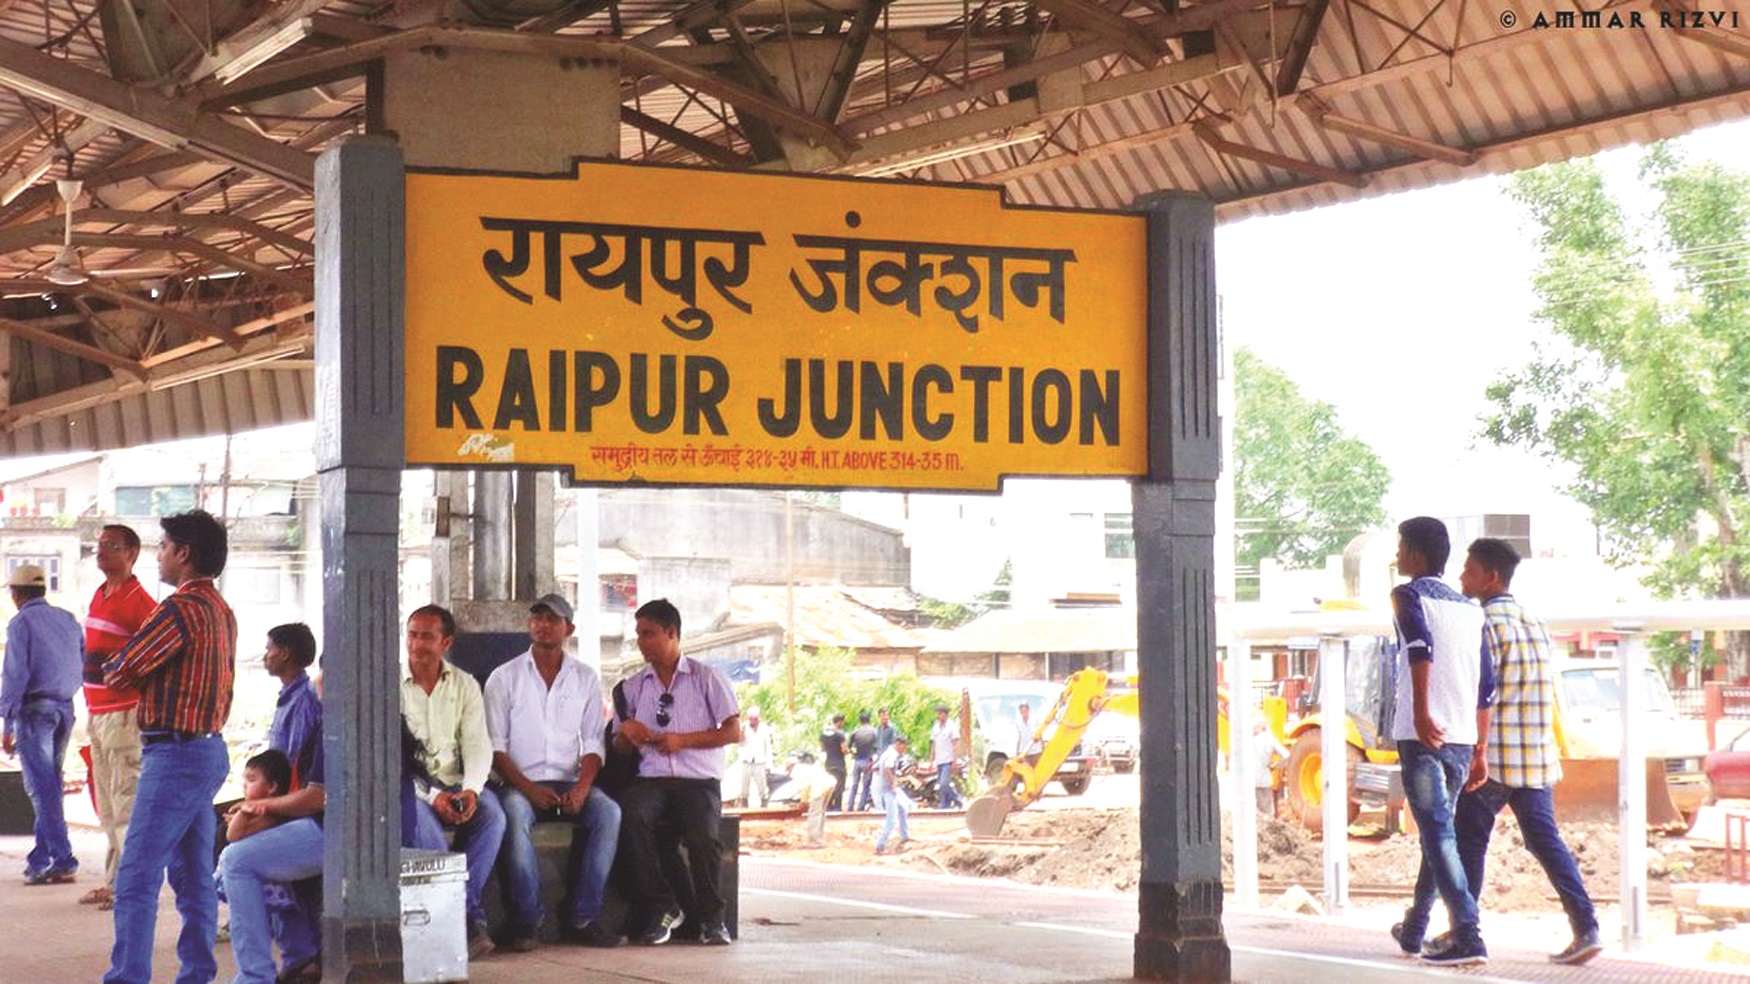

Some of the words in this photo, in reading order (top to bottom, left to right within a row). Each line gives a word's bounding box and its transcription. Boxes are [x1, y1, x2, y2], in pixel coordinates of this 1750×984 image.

[480, 217, 765, 340] रायपुर
[788, 211, 1075, 332] जंक्शन
[436, 345, 729, 436] RAIPUR
[757, 358, 1120, 446] JUNCTION
[652, 447, 678, 467] तल
[681, 443, 698, 467] से
[842, 451, 887, 470] ABOVE
[889, 451, 942, 470] 314-35
